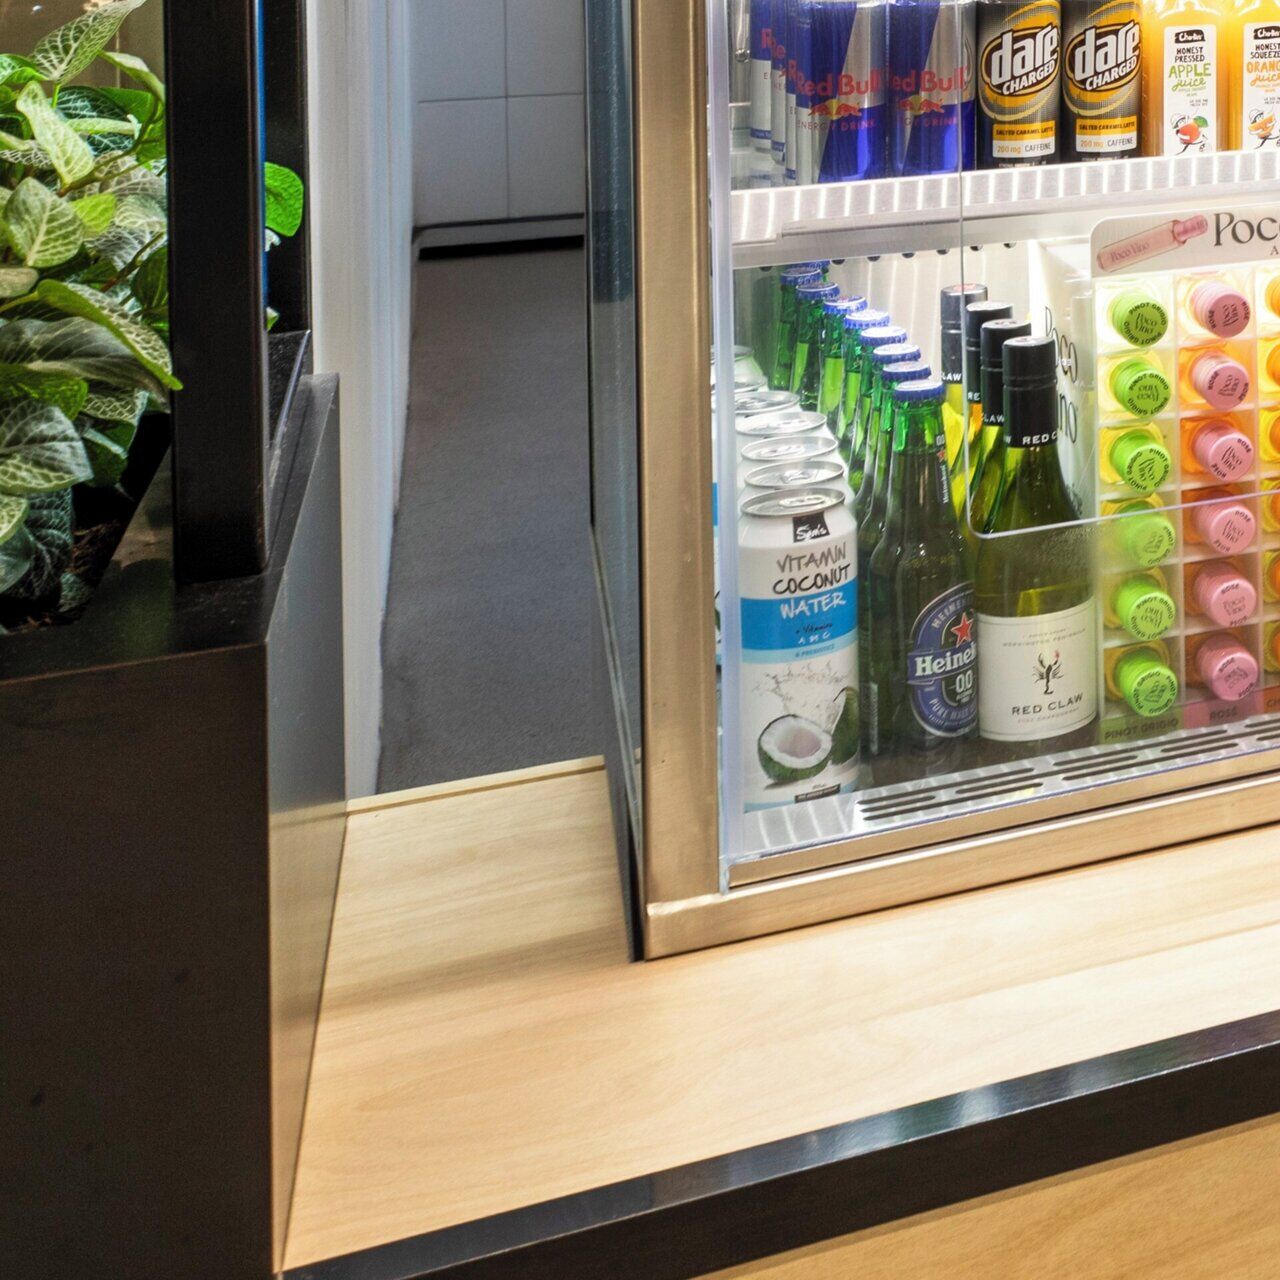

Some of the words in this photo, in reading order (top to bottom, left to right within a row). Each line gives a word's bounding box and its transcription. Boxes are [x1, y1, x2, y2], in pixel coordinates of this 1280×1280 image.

[991, 24, 1058, 86] dare
[1075, 21, 1140, 81] dare
[1176, 47, 1203, 55] HONEST
[1174, 55, 1205, 63] PRESSED
[1002, 59, 1056, 96] CHARGED
[1085, 55, 1137, 91] CHARGED
[1168, 63, 1212, 78] APPLE
[1171, 78, 1206, 92] juice
[1025, 142, 1052, 152] CAFFEINE
[1107, 137, 1133, 147] CAFFEINE
[1270, 245, 1279, 256] A
[1022, 434, 1050, 445] RED
[777, 541, 847, 574] VITAMIN
[772, 564, 851, 596] COCONUT
[780, 591, 846, 620] WATER
[1011, 704, 1042, 716] RED
[1047, 693, 1084, 711] CLAW
[1104, 727, 1138, 740] PINOT
